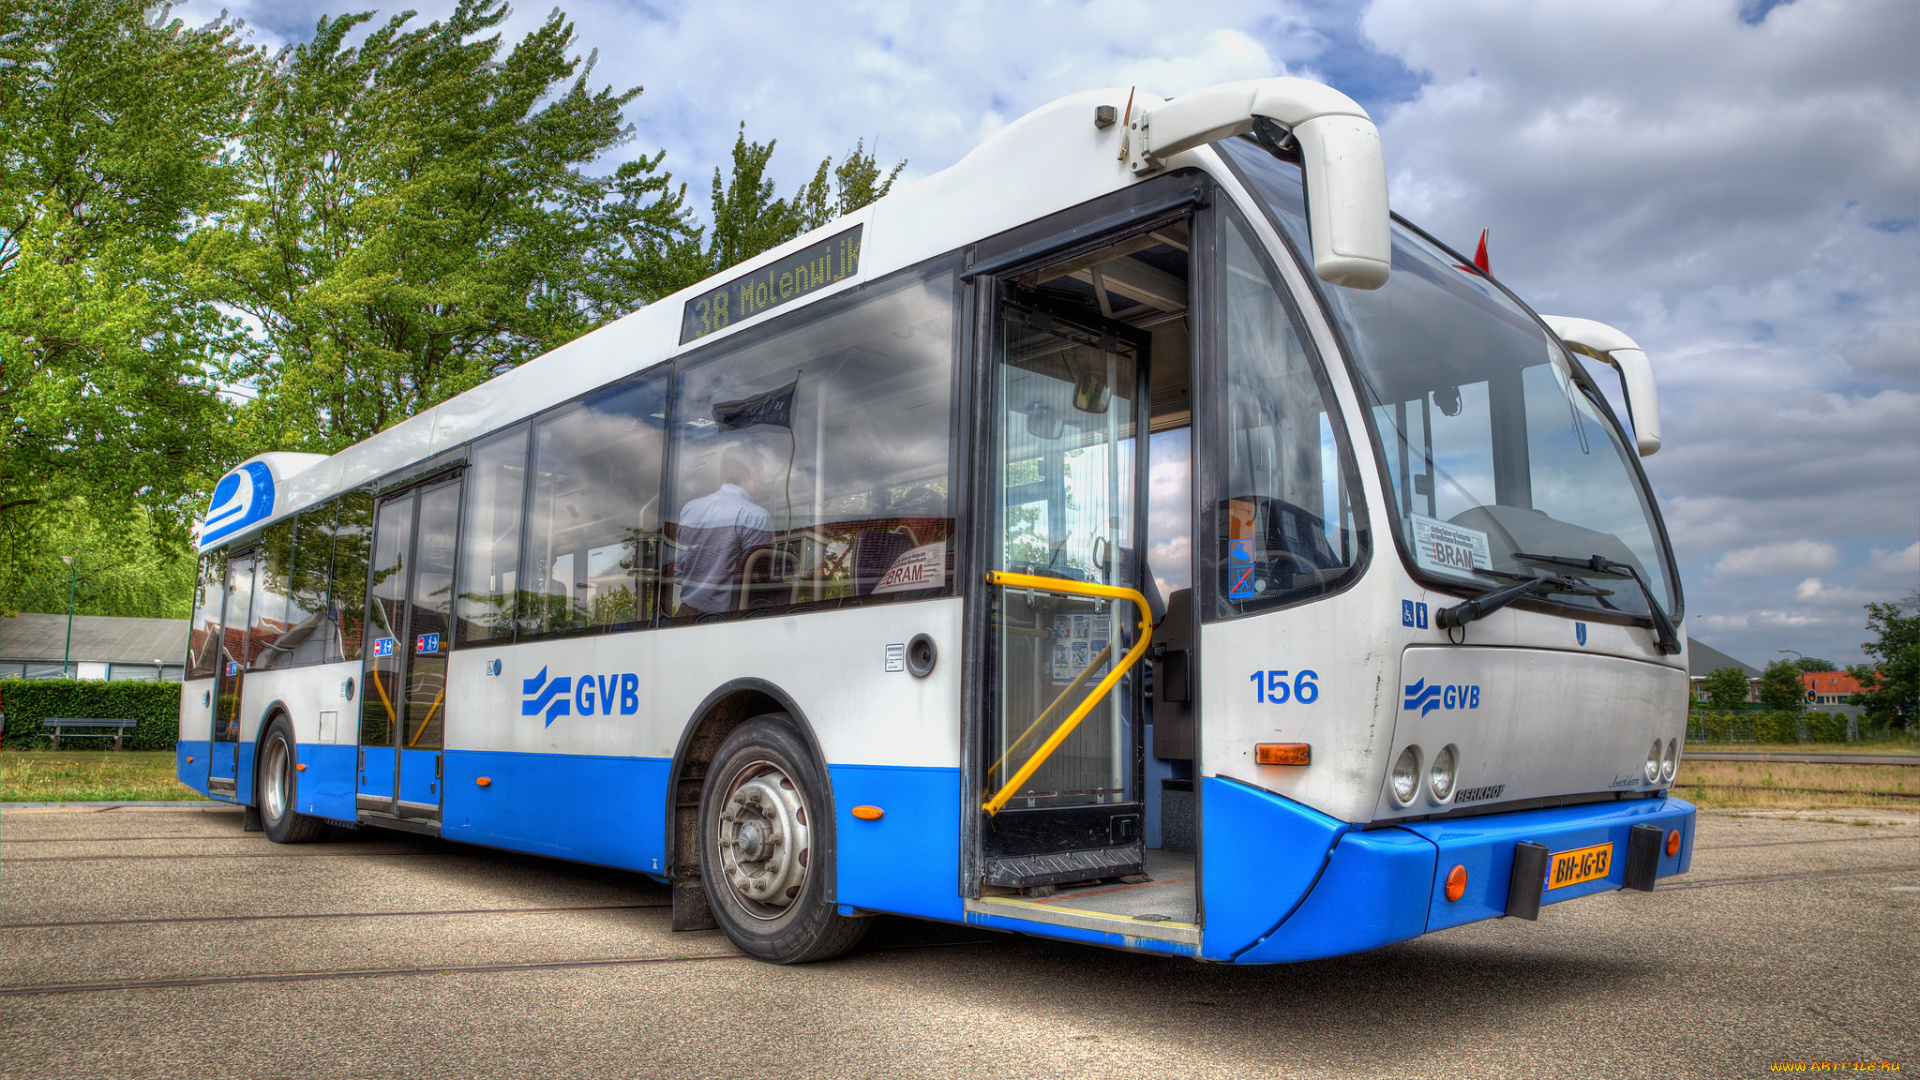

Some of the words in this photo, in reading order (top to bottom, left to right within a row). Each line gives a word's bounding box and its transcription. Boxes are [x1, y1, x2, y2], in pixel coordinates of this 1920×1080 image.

[695, 291, 729, 339] 38
[740, 237, 861, 316] Molenwijk
[1436, 542, 1475, 569] BRAM
[886, 564, 923, 585] BRAM
[575, 673, 639, 716] GVB
[1250, 670, 1319, 704] 156
[1443, 685, 1480, 710] GVB
[1454, 784, 1505, 803] BERKHOF
[1556, 850, 1607, 883] BH-JG-13
